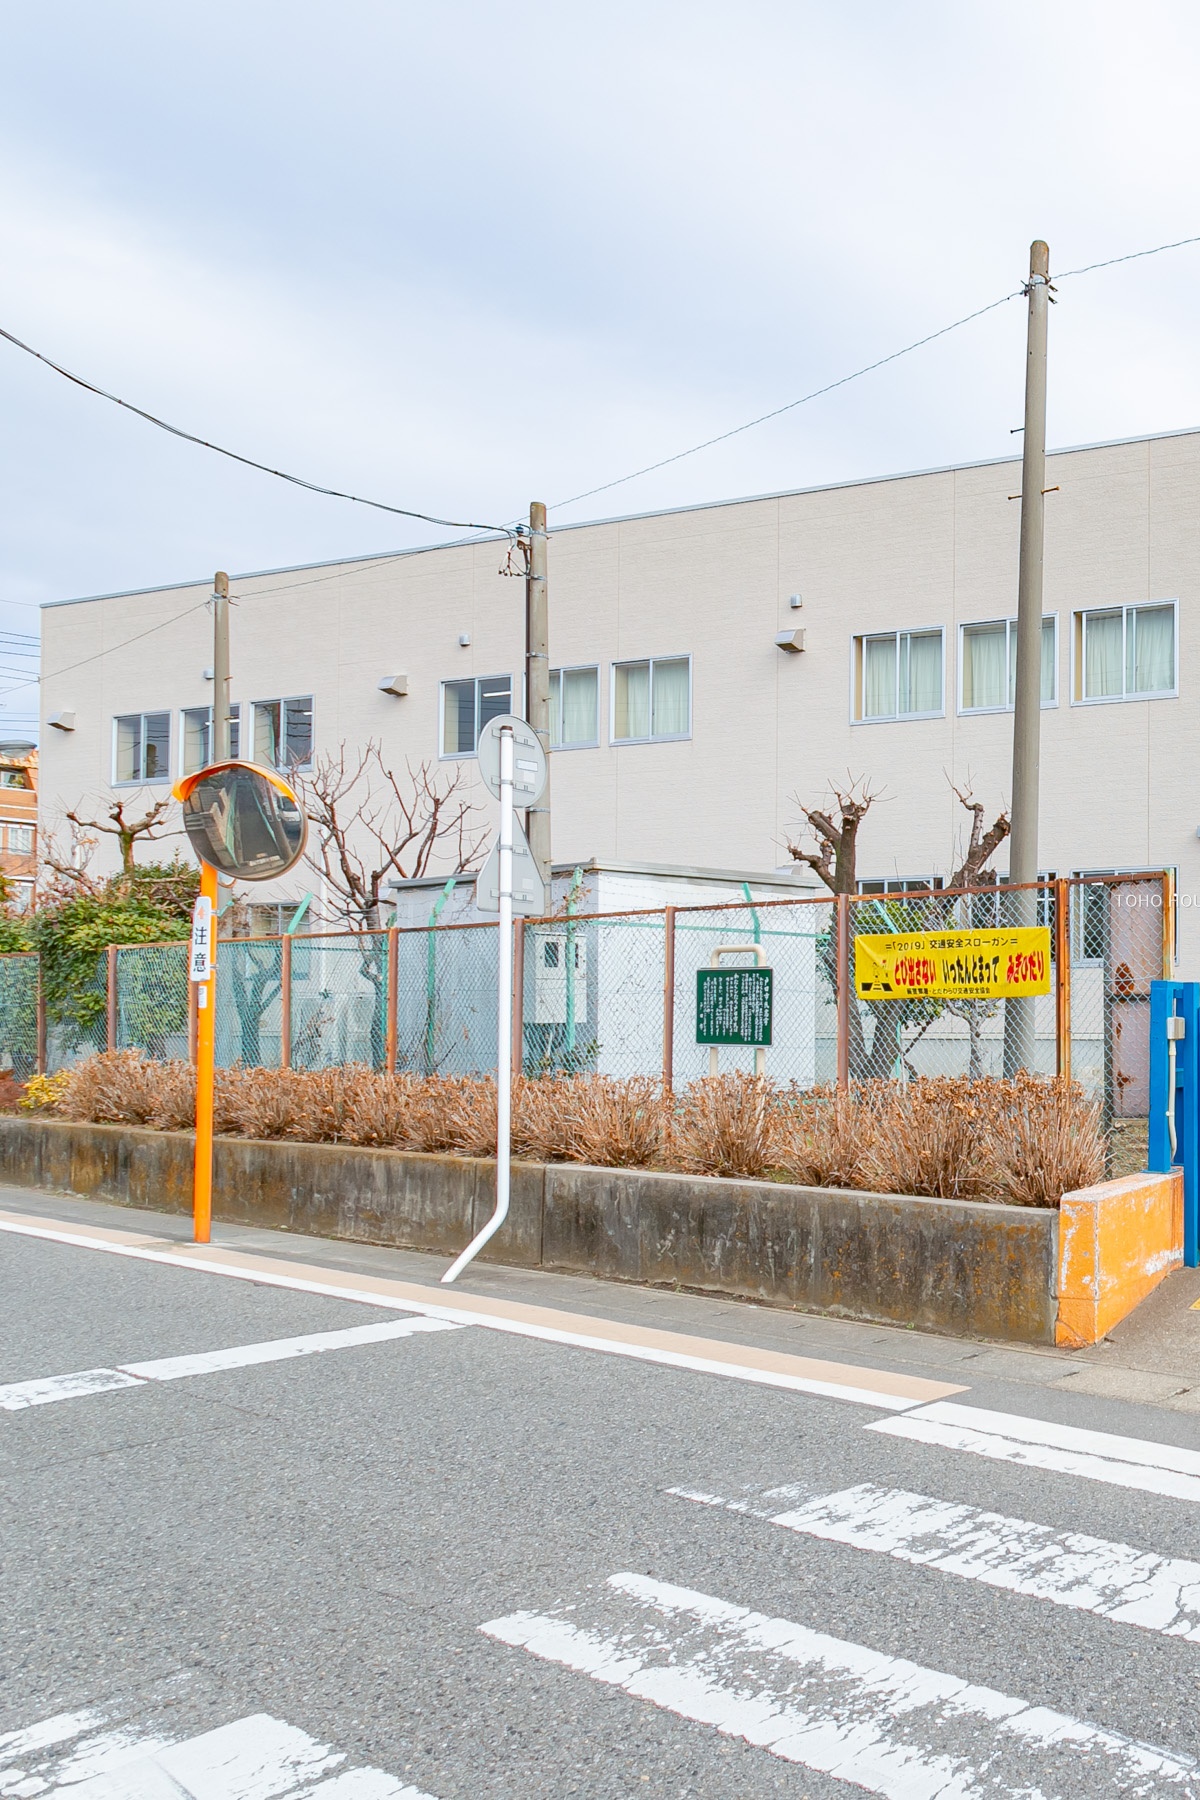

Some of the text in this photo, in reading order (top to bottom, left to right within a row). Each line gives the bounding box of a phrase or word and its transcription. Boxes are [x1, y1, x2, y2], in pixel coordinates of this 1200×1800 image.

[193, 926, 208, 972] 注意
[894, 950, 1045, 987] とび出さない いったんとまって みぎひだり
